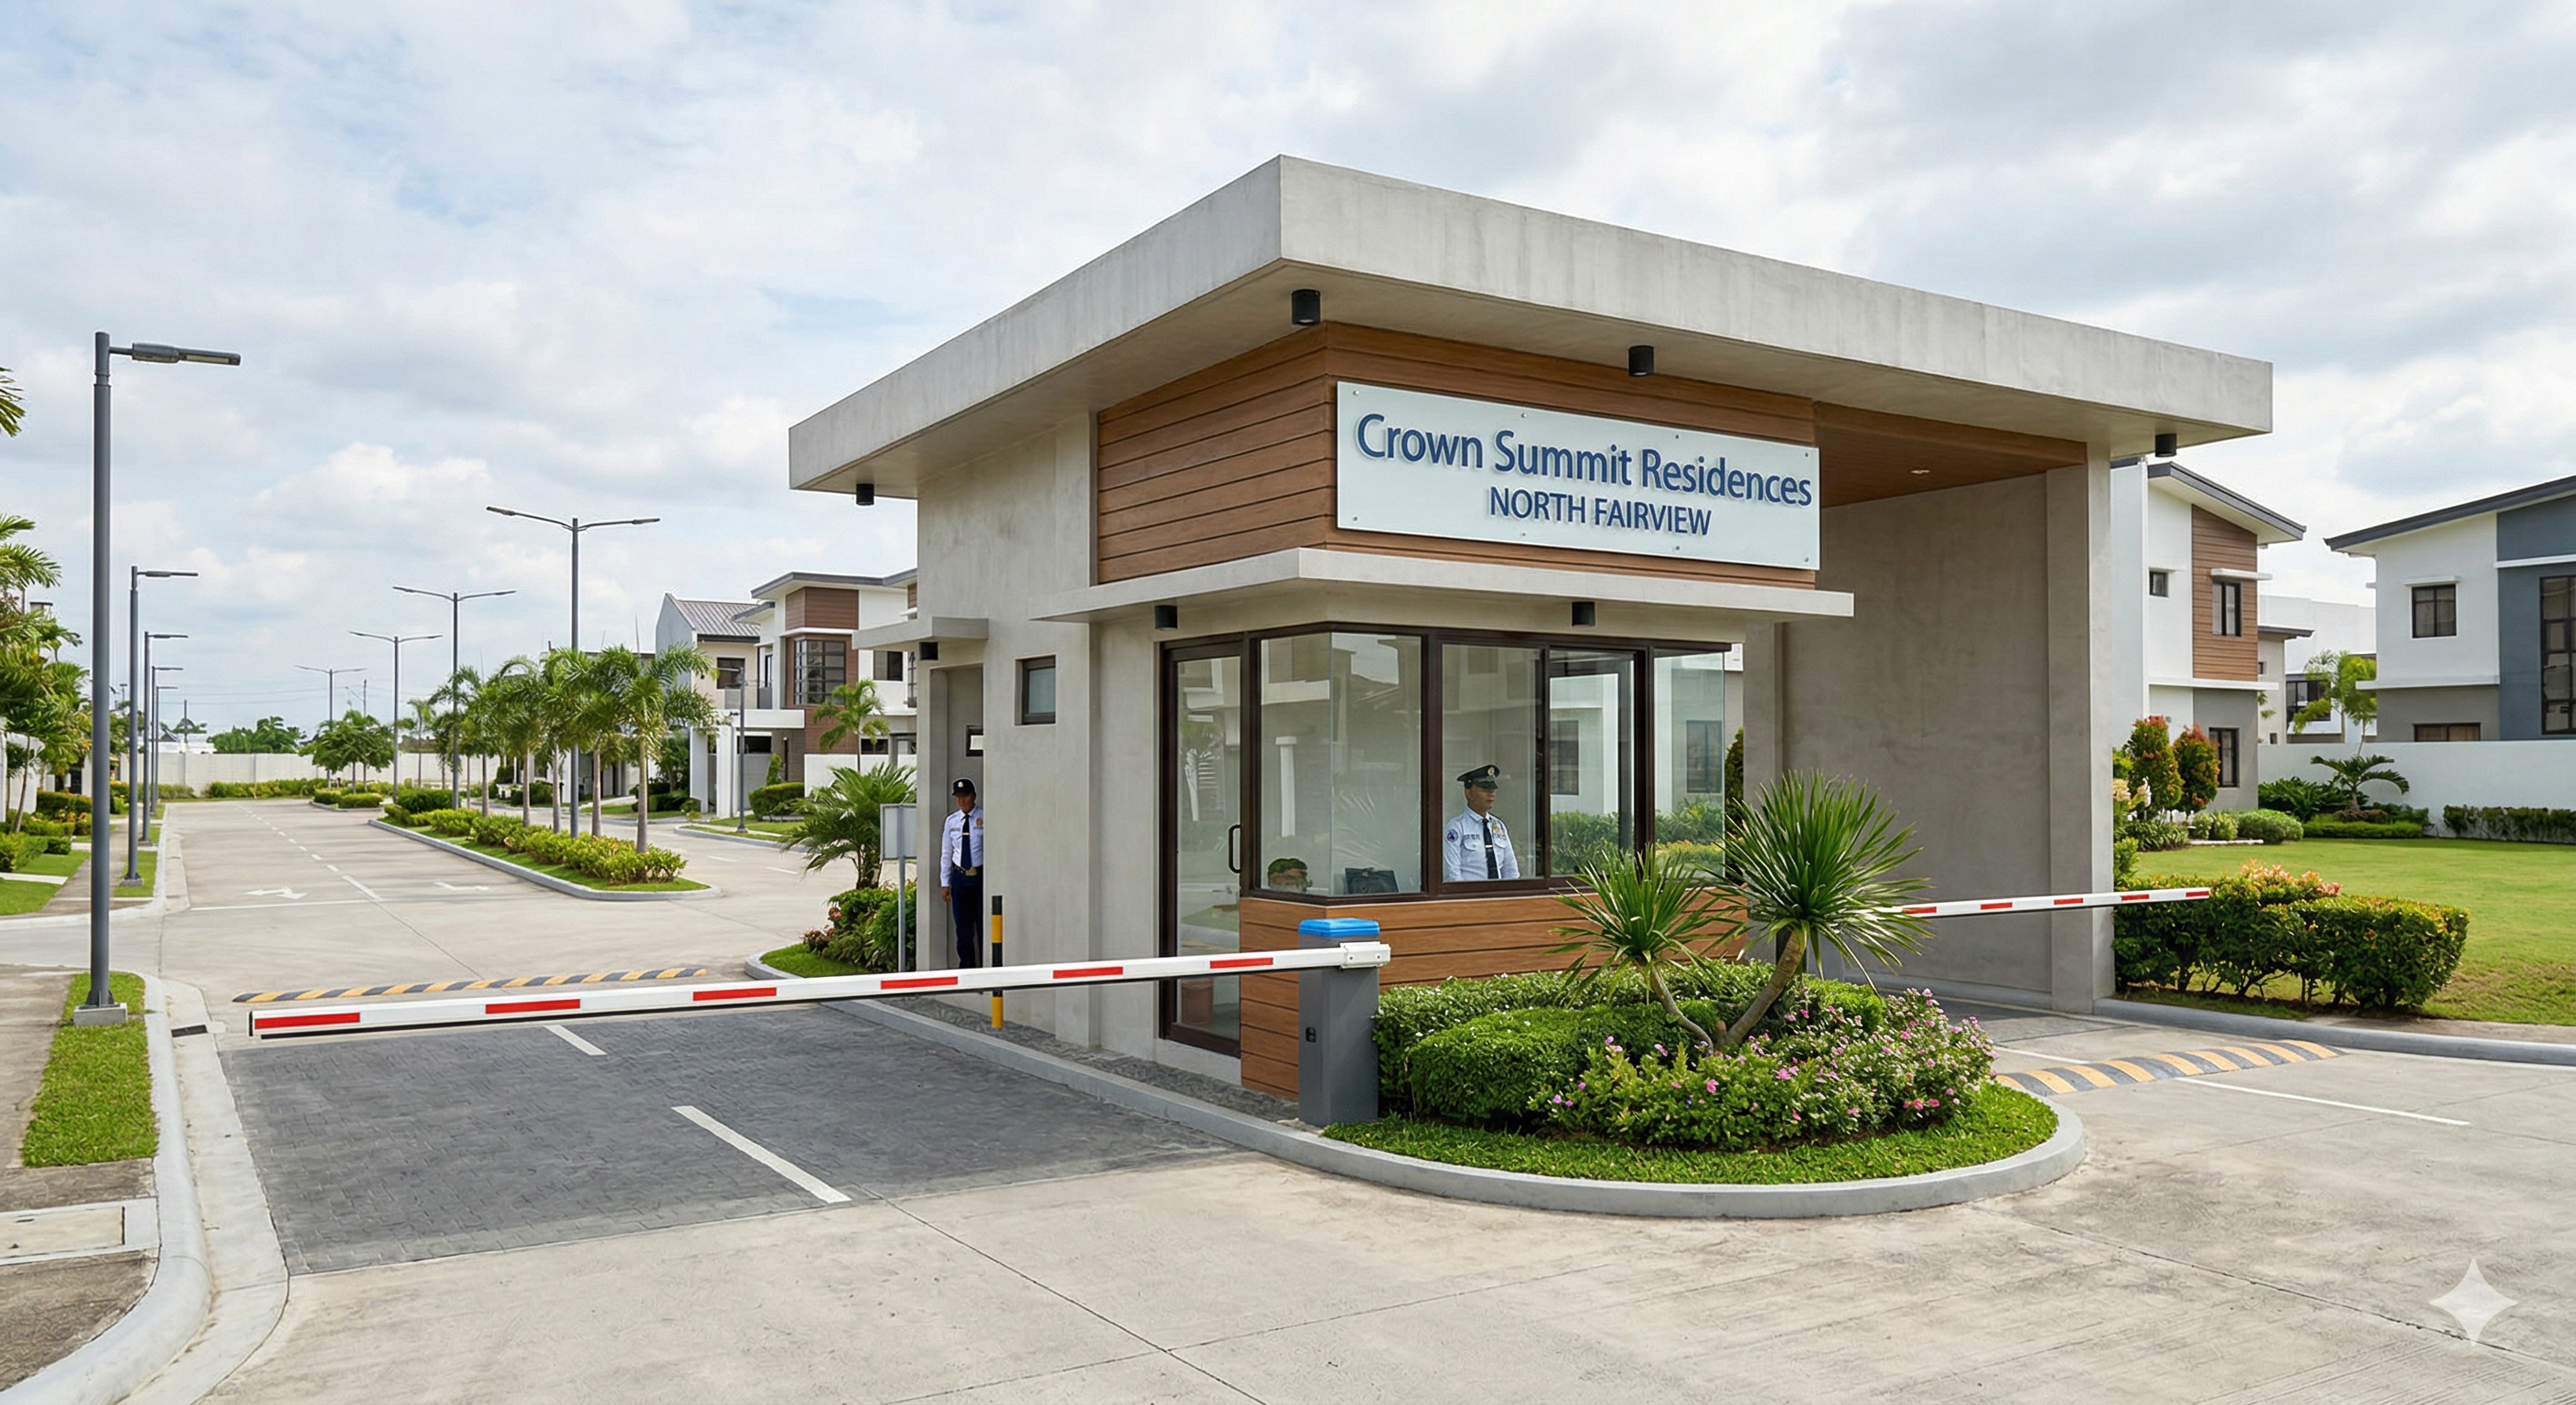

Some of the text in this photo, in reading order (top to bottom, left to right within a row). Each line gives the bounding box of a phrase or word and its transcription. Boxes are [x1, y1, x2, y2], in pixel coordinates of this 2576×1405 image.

[1357, 413, 1812, 507] Crown Summit Residences
[1490, 487, 1712, 536] NORTH FAIRVIEW
